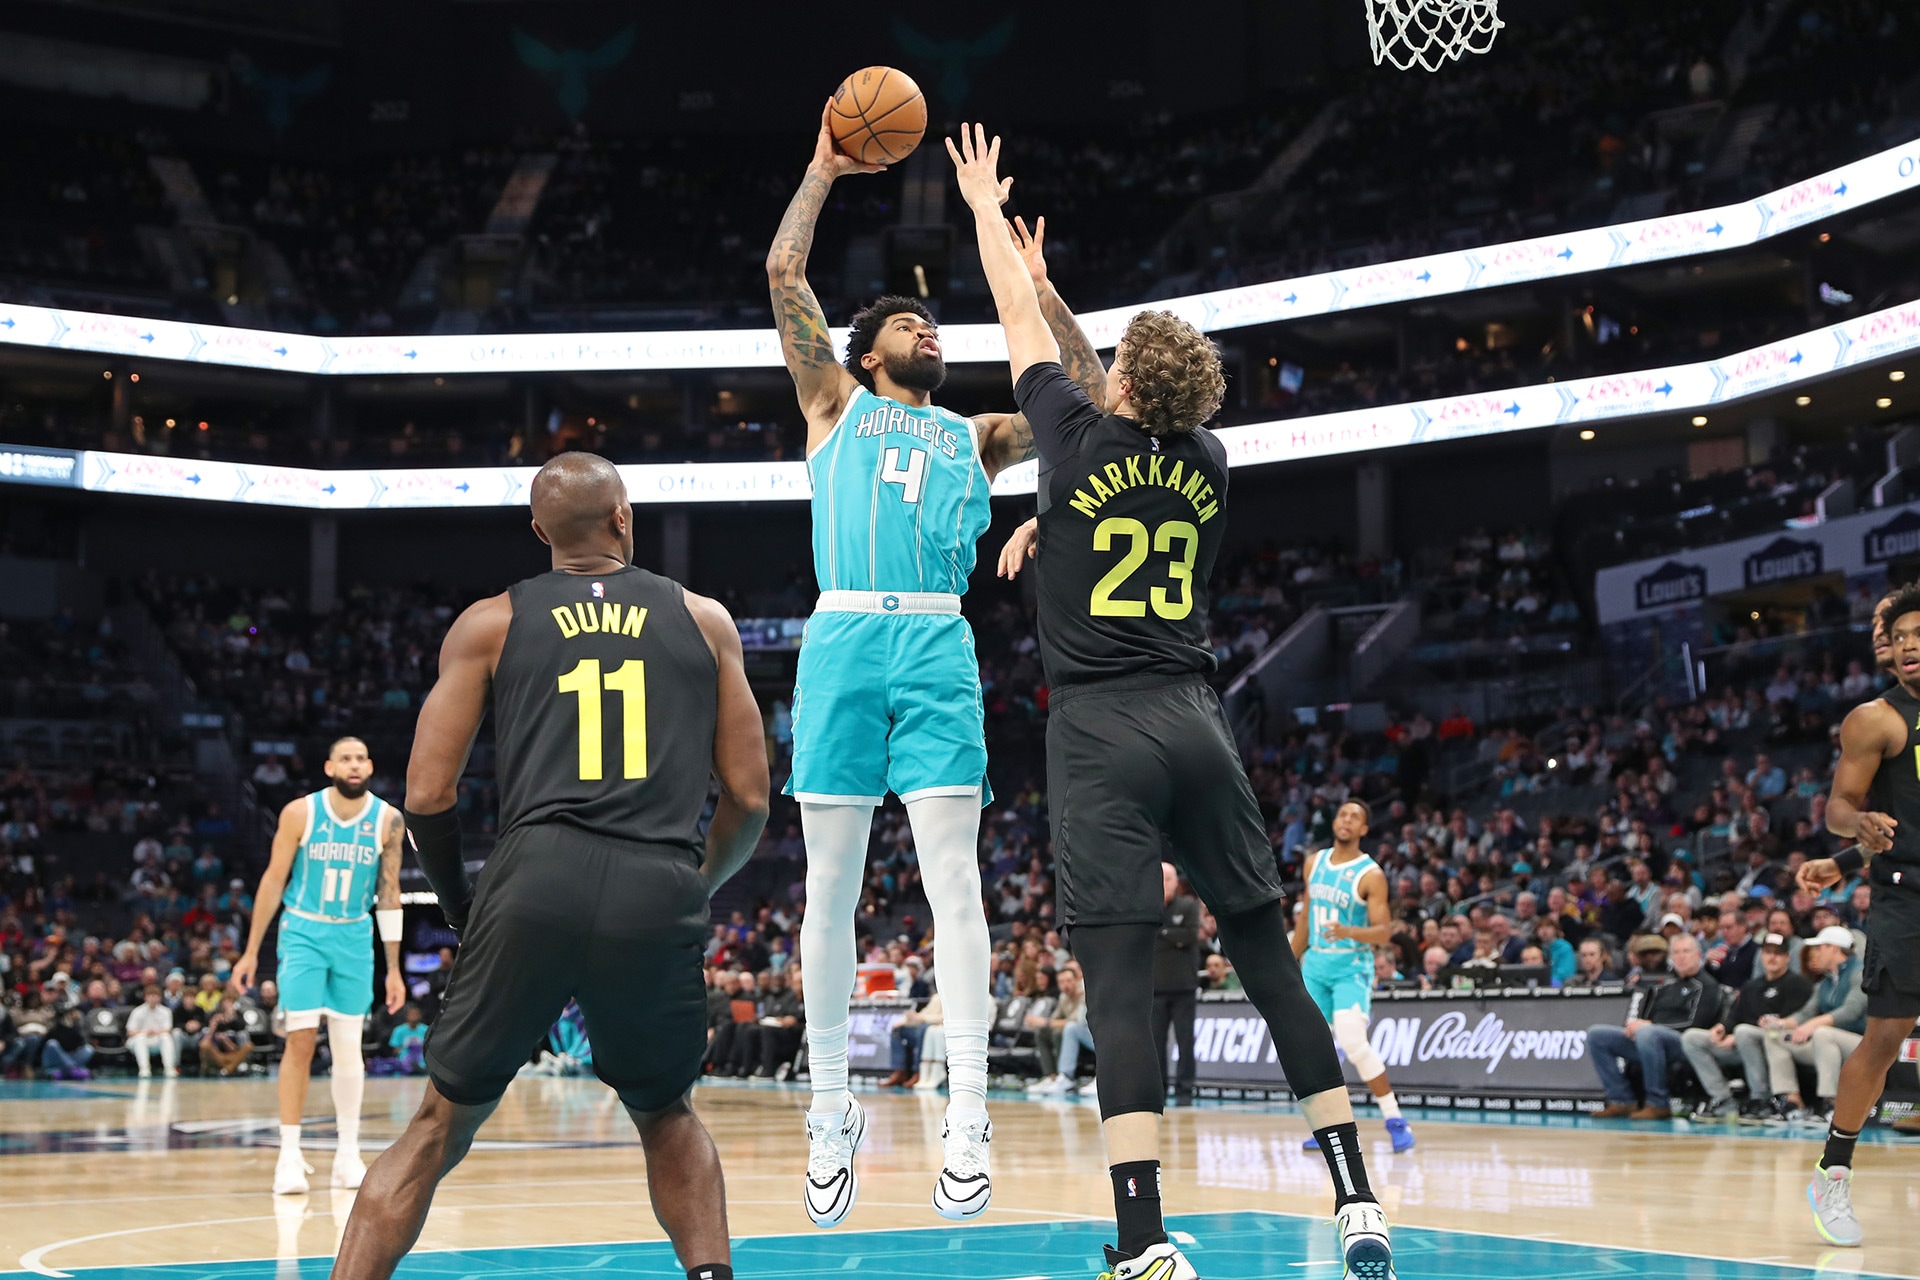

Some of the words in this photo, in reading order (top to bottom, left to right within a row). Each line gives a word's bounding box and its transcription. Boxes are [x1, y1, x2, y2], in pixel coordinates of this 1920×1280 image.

[855, 405, 959, 460] HORNETS
[1291, 423, 1393, 448] Hornets
[659, 474, 757, 492] Official
[880, 446, 928, 504] 4
[1068, 454, 1219, 524] MARKKANEN
[1090, 517, 1199, 620] 23
[1752, 552, 1817, 583] LOWE'S
[1641, 575, 1700, 602] LOWE'S
[551, 602, 648, 639] DUNN
[558, 658, 648, 781] 11
[308, 841, 375, 866] HORNETS
[323, 867, 354, 903] 11
[1370, 1017, 1421, 1067] ON
[1418, 1011, 1516, 1075] Bally
[1510, 1029, 1588, 1061] SPORTS
